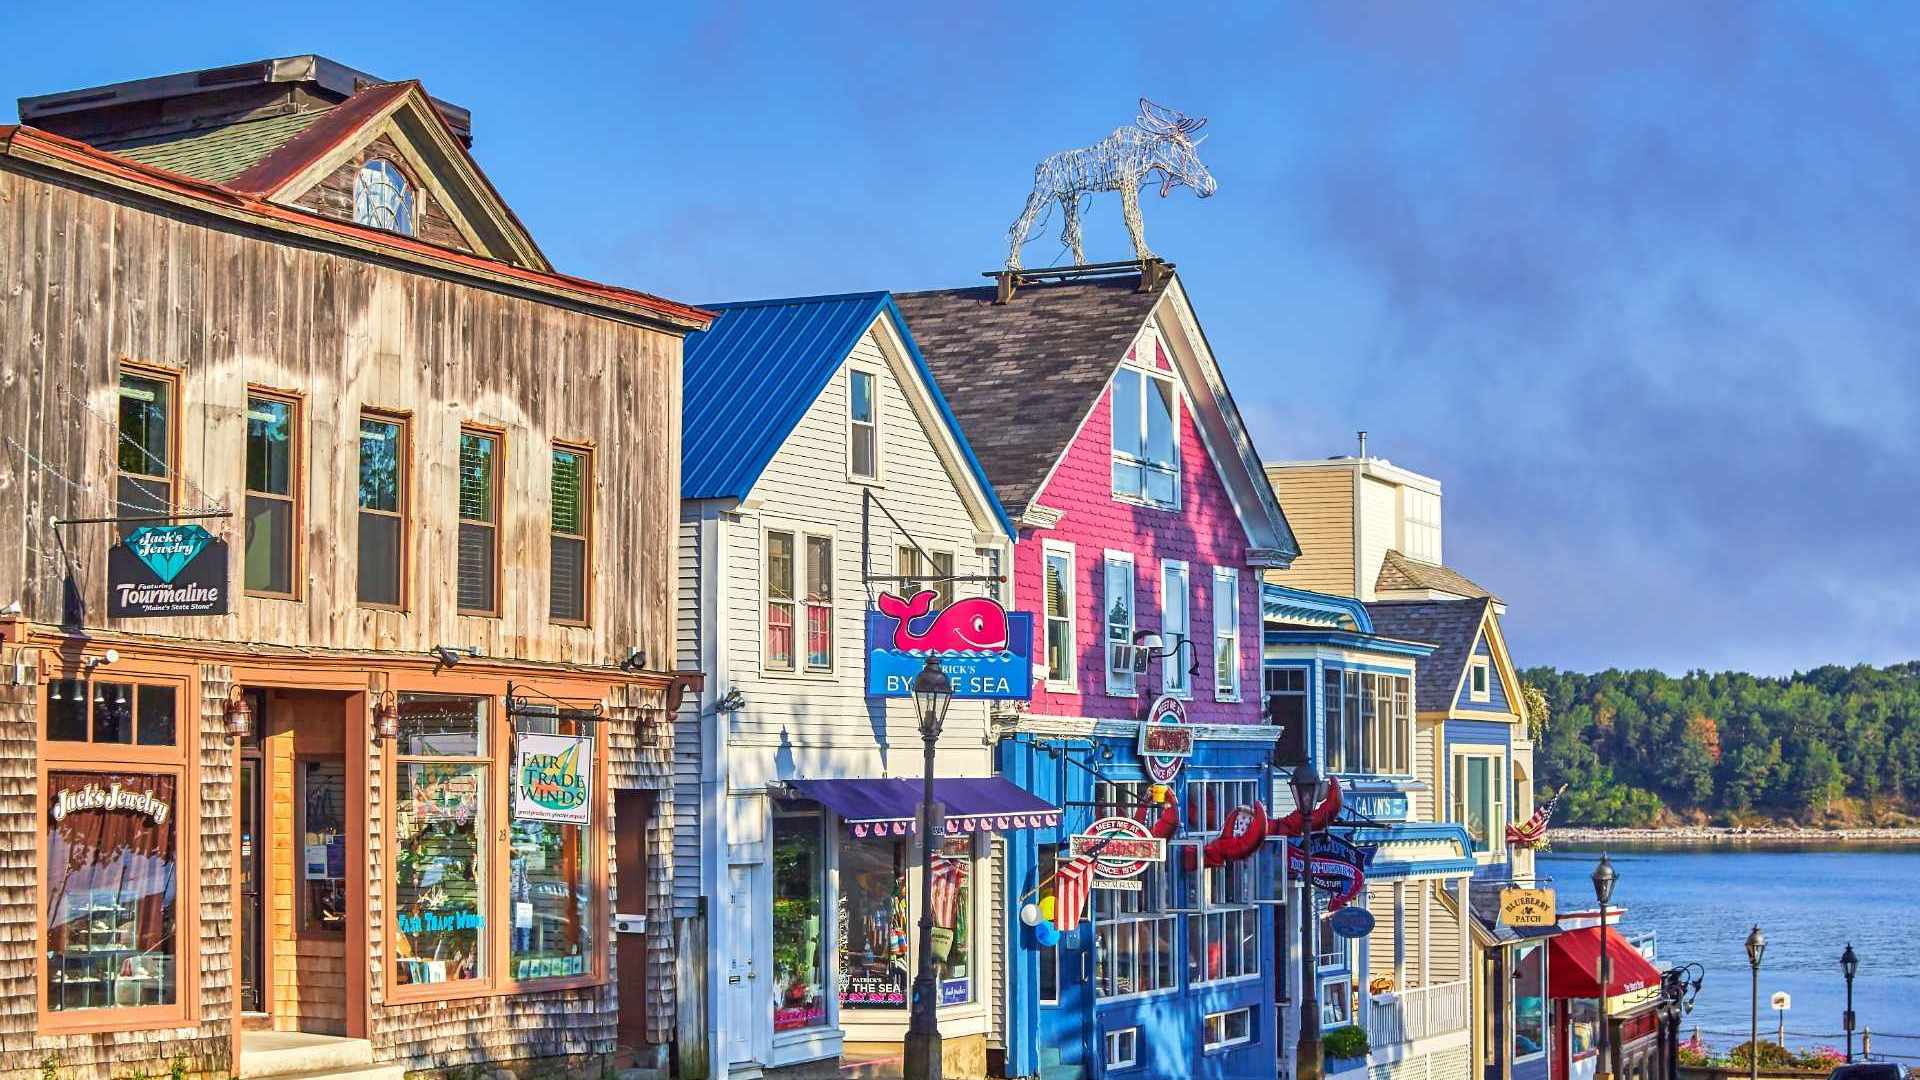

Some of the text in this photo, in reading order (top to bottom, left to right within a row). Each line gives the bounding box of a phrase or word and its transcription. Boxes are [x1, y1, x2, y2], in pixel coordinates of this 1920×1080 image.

[139, 531, 183, 546] Jack's
[139, 542, 194, 556] Jewelry
[116, 582, 219, 608] Tourmaline
[887, 675, 913, 692] BY
[970, 675, 1010, 692] SEA
[520, 751, 561, 769] FAIR
[525, 768, 585, 788] TRADE
[53, 781, 170, 824] Jack's Jewelry
[519, 785, 585, 806] WINDS
[1095, 820, 1139, 834] MEET ME AT
[1096, 863, 1120, 875] SINCE
[1504, 897, 1551, 913] BLUEBERRY
[1515, 915, 1541, 923] PATCH
[852, 983, 876, 993] THE
[878, 983, 901, 993] SEA
